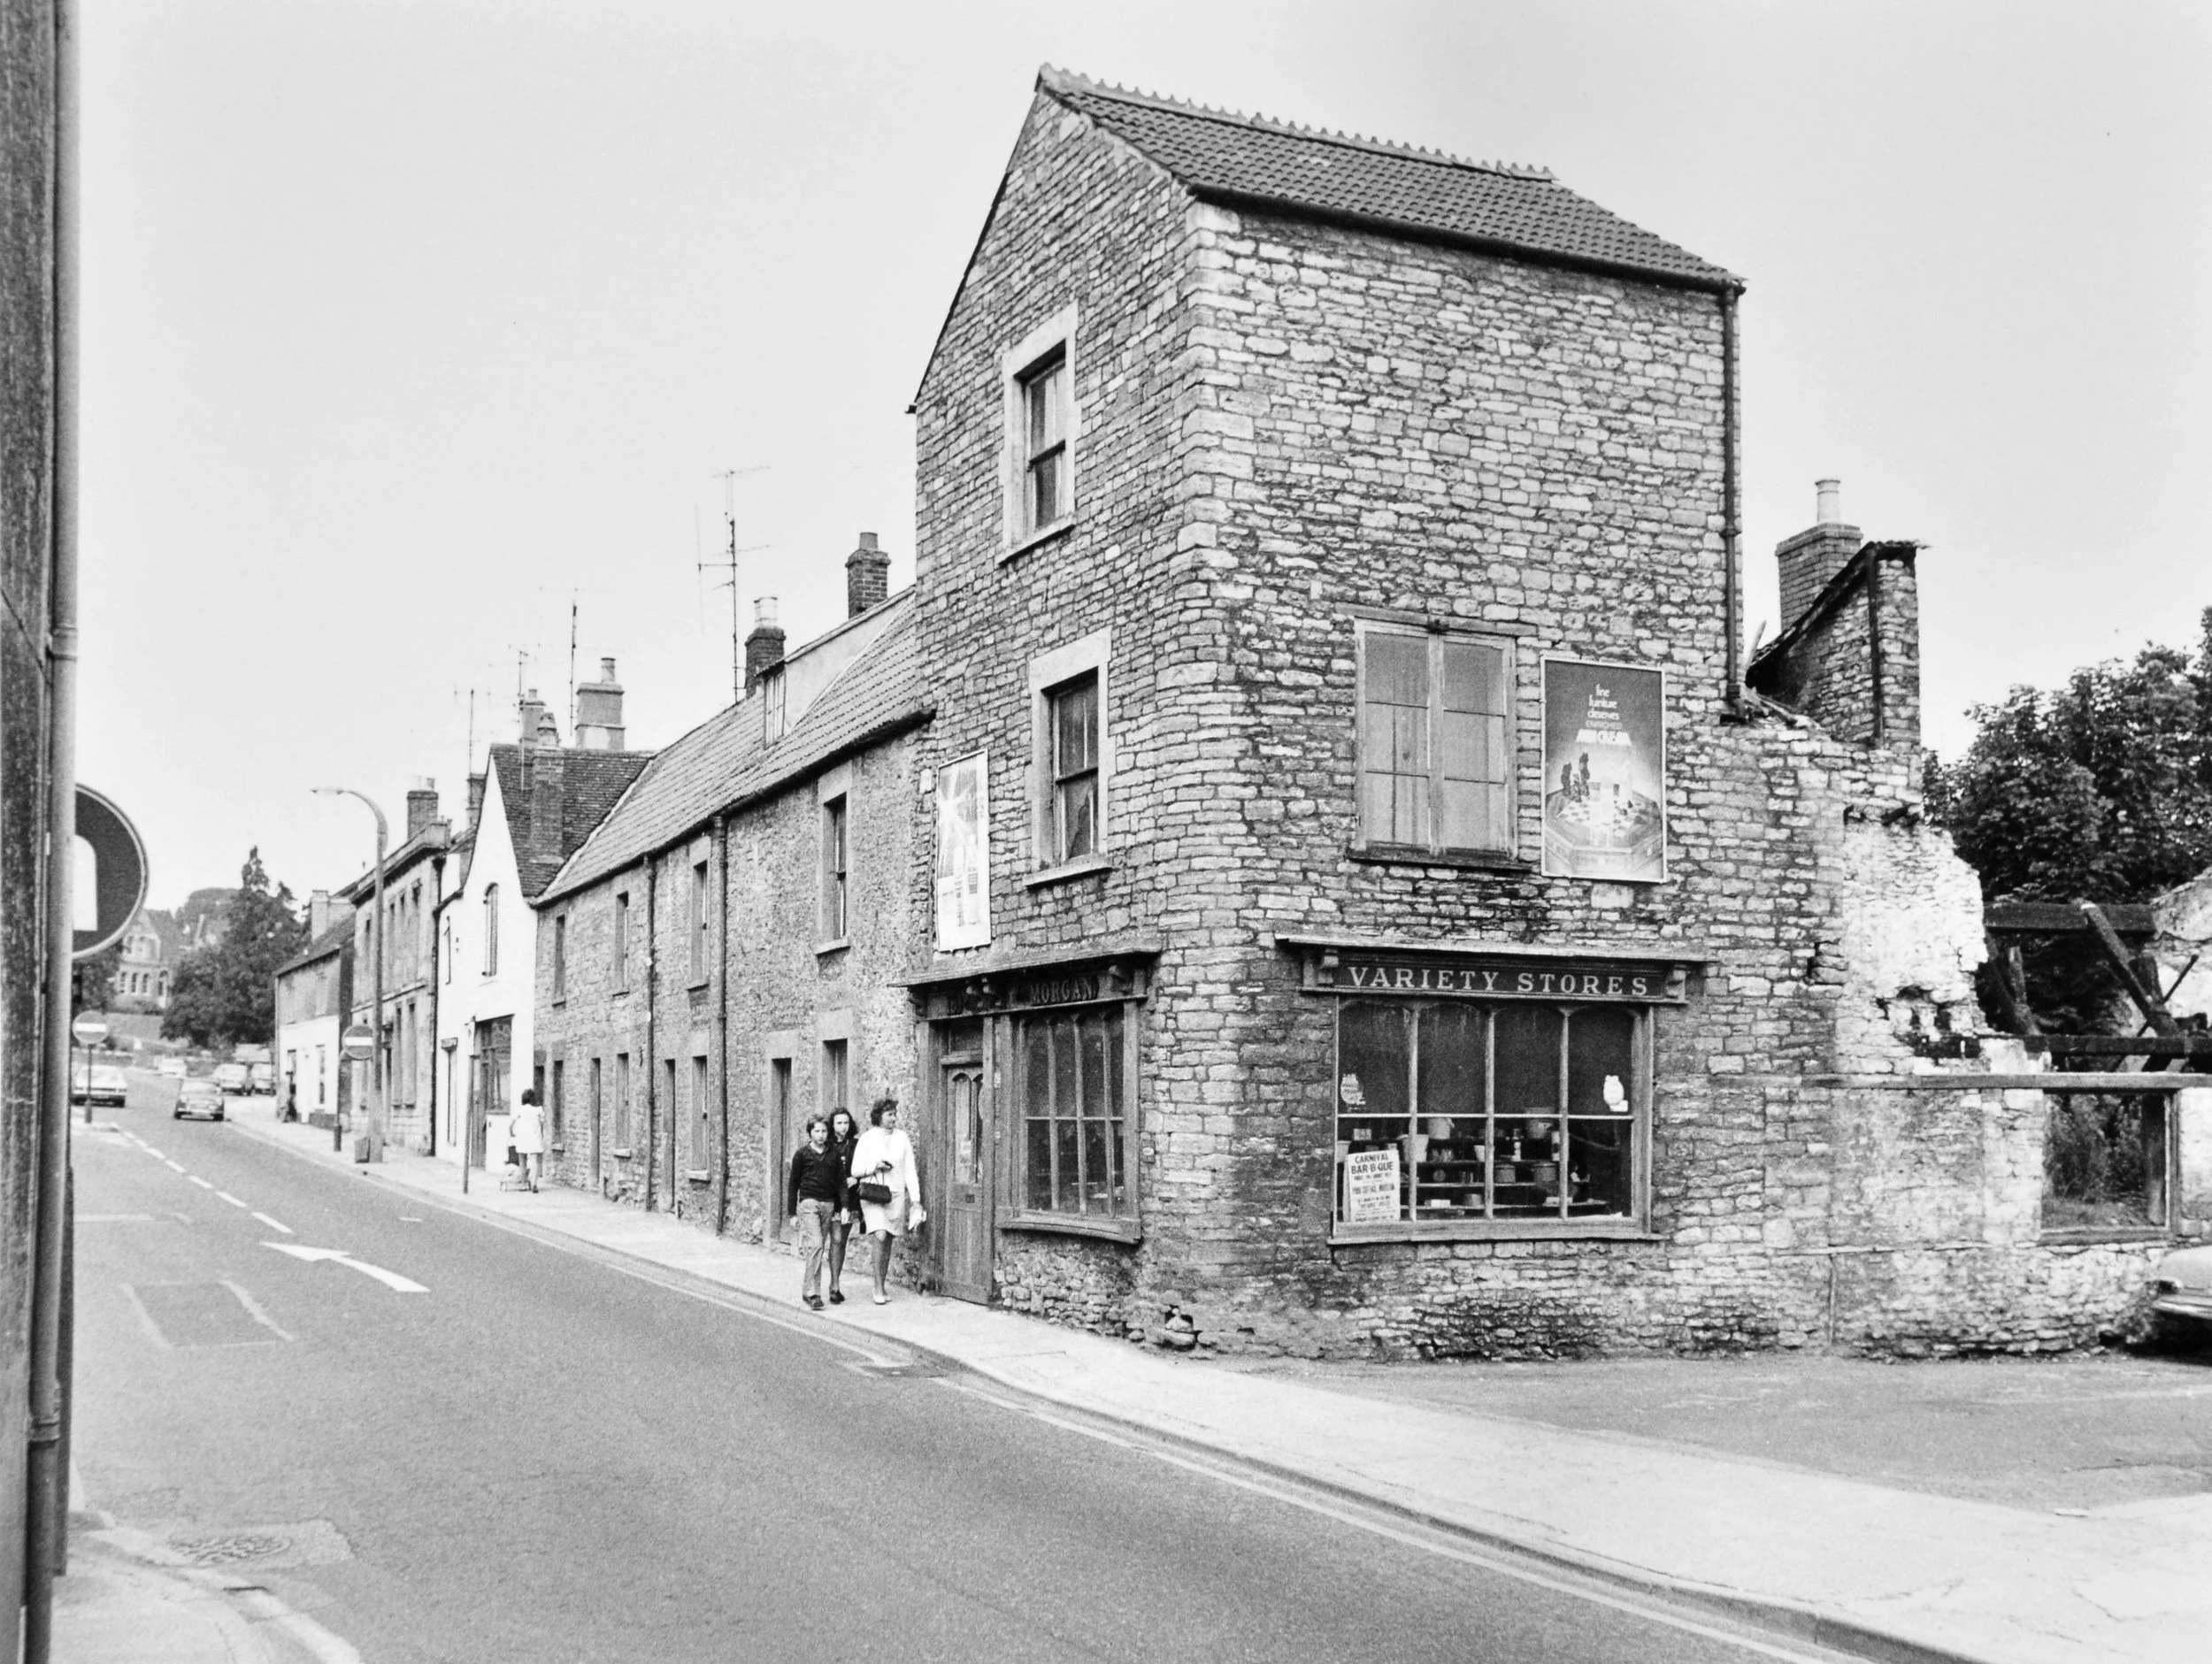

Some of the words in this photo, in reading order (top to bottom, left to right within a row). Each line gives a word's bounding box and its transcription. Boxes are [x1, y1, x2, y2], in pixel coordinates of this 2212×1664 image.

[1030, 977, 1093, 1005] MORGAN
[1348, 966, 1500, 992] VARIETY
[1517, 972, 1648, 997] STORES
[1355, 1153, 1388, 1164] CARNIVAL
